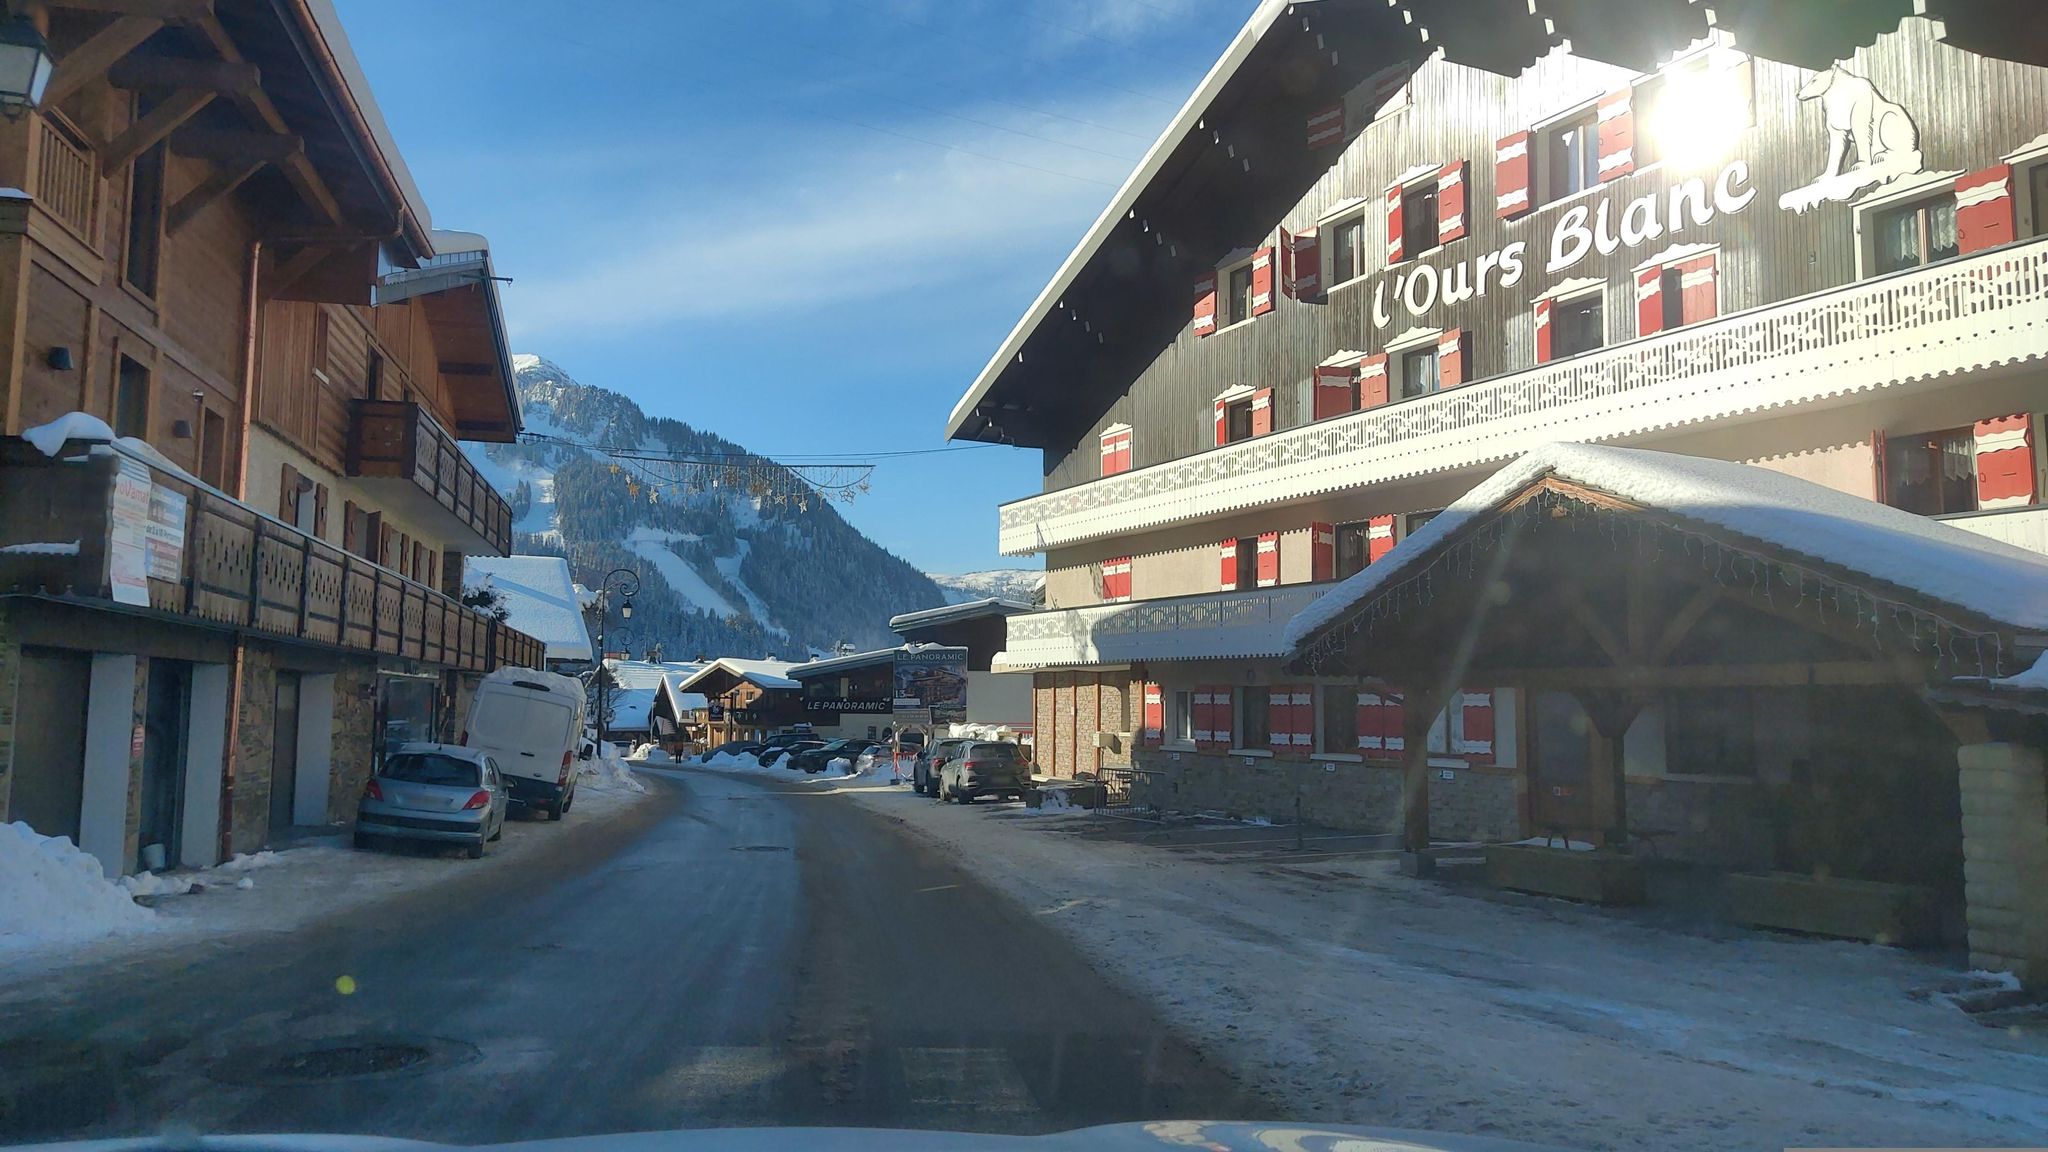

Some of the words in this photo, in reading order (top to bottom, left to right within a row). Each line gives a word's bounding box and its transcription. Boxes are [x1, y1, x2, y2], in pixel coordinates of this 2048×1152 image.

[1546, 159, 1758, 274] Blanc
[897, 653, 908, 661] LE
[910, 653, 963, 661] PANORAMIC
[807, 701, 821, 710] LE
[822, 701, 886, 710] PANORAMIC
